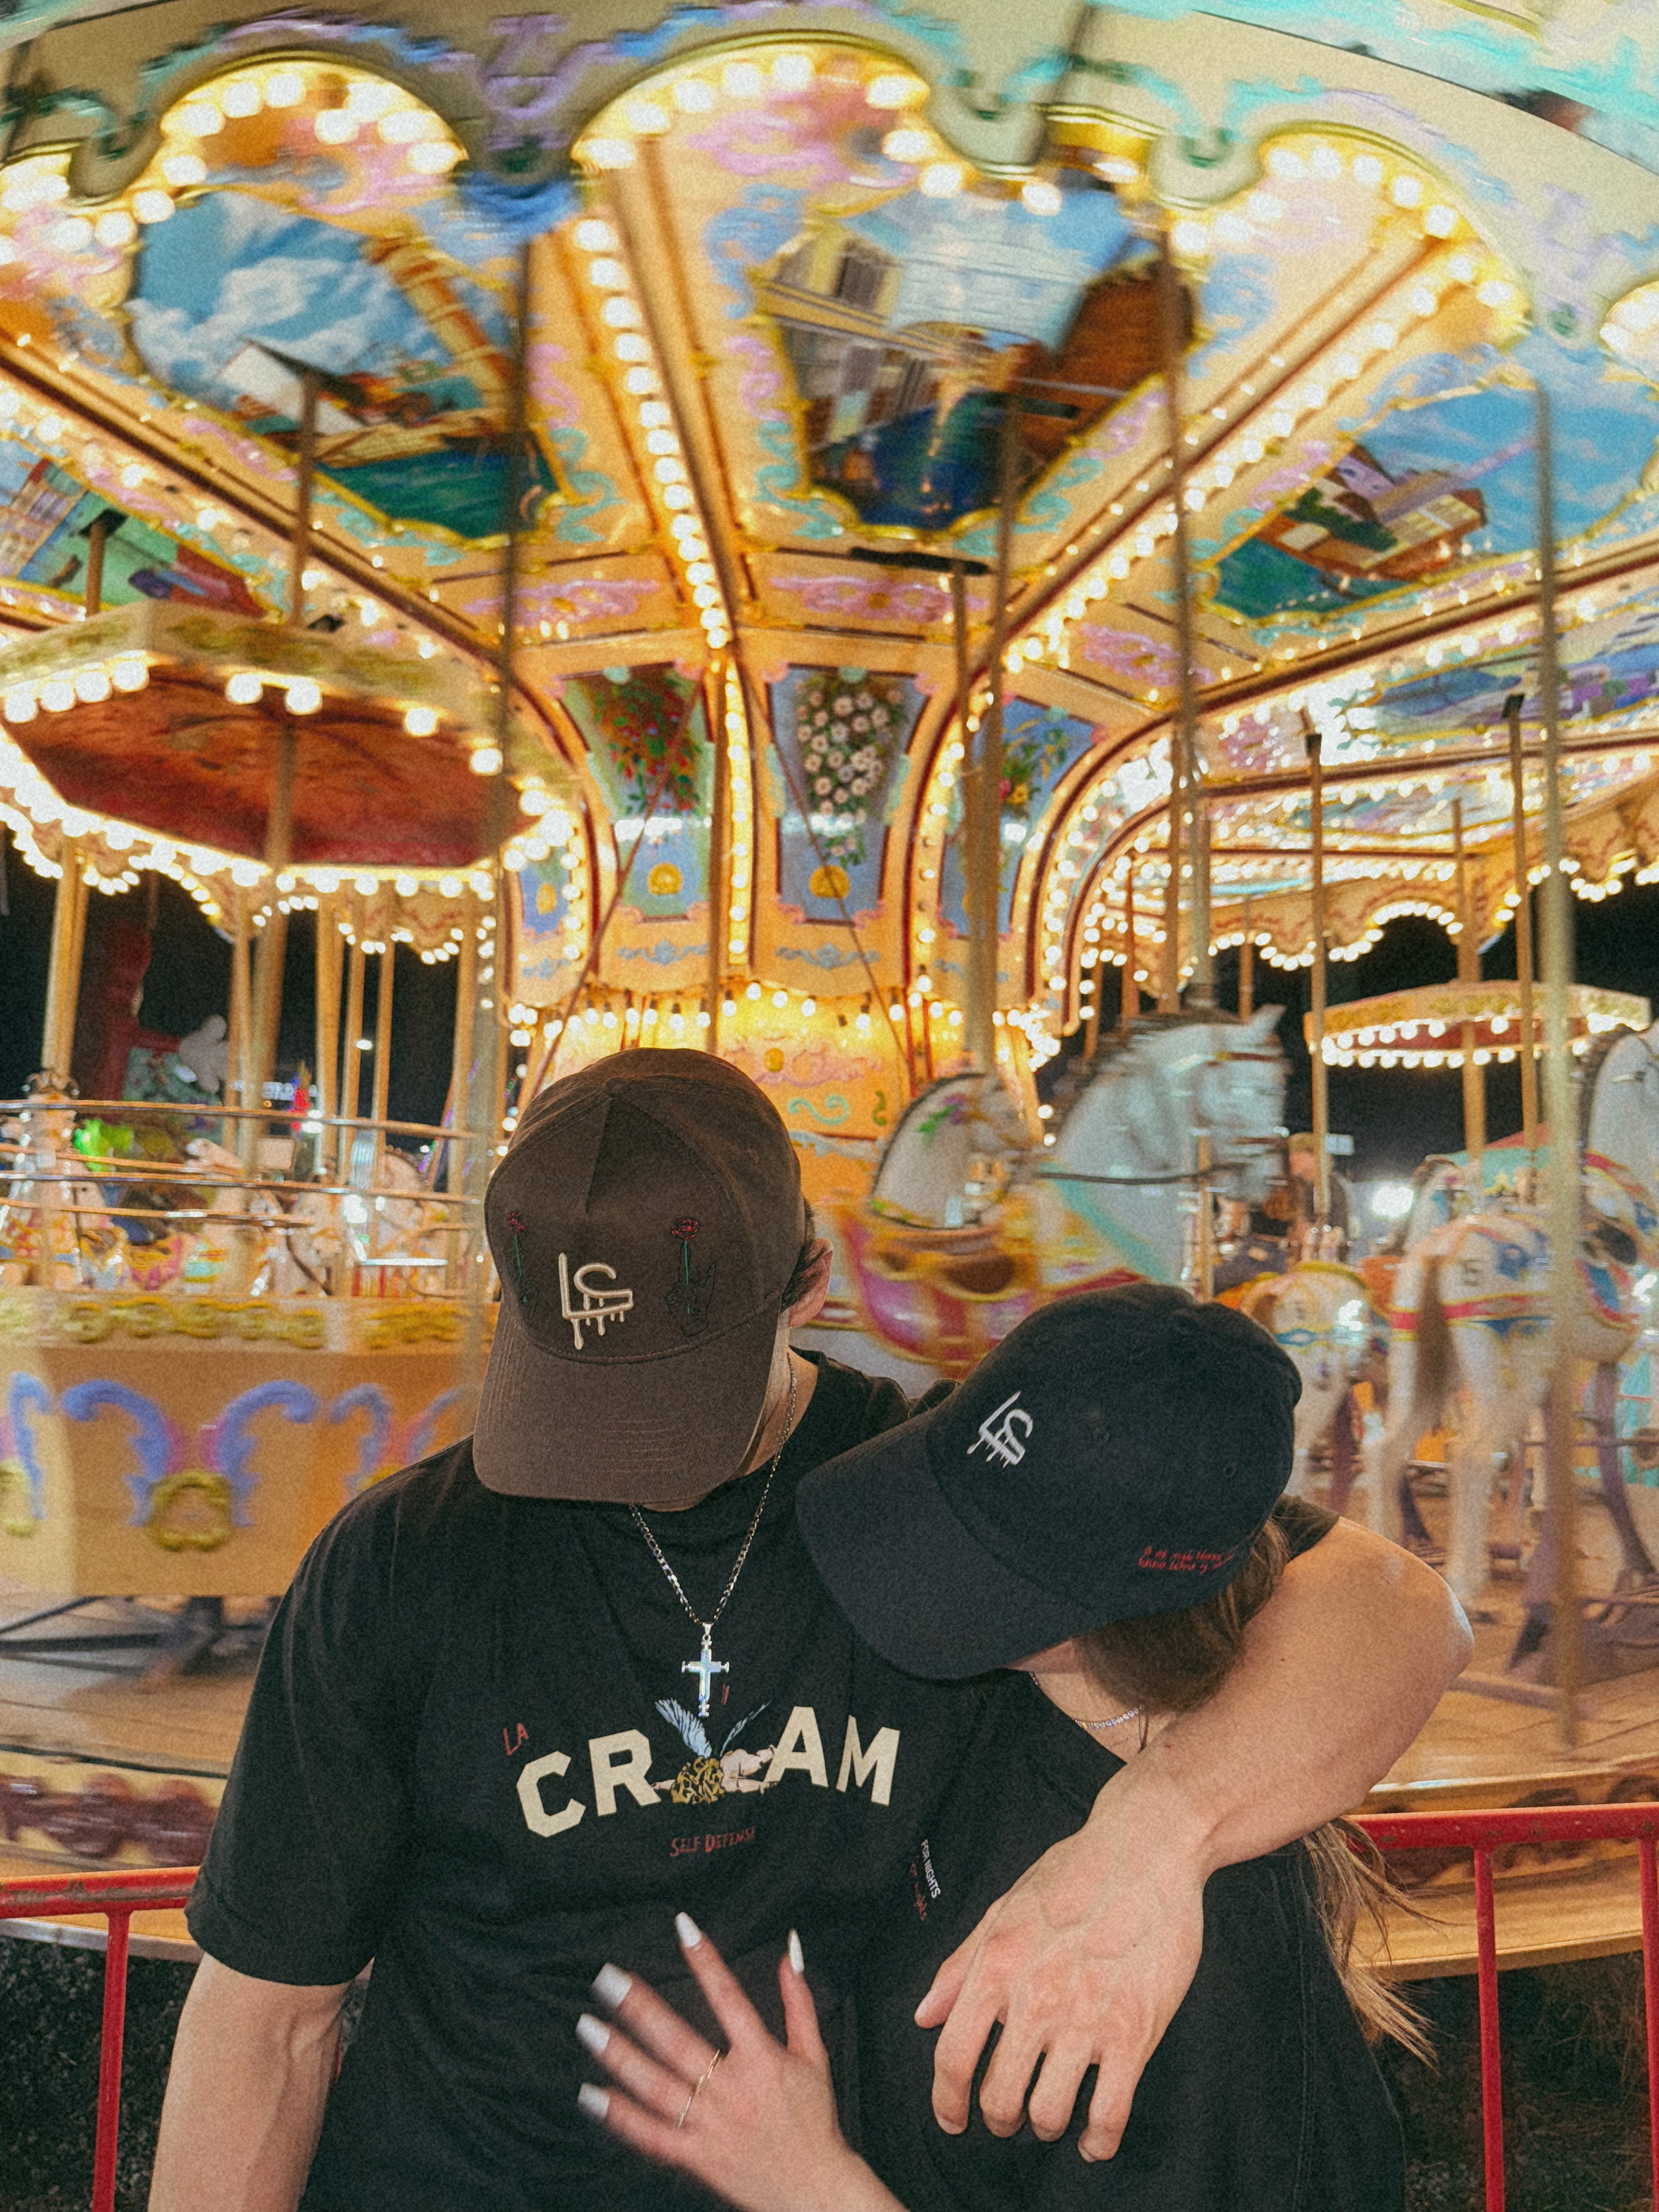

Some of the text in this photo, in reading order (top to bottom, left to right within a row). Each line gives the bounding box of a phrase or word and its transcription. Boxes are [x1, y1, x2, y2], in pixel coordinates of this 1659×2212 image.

[503, 1723, 529, 1756] LA
[517, 1706, 900, 1837] CRAM
[670, 1826, 755, 1857] SELF DEFENSE
[921, 1839, 940, 1898] FOR NIGHTS
